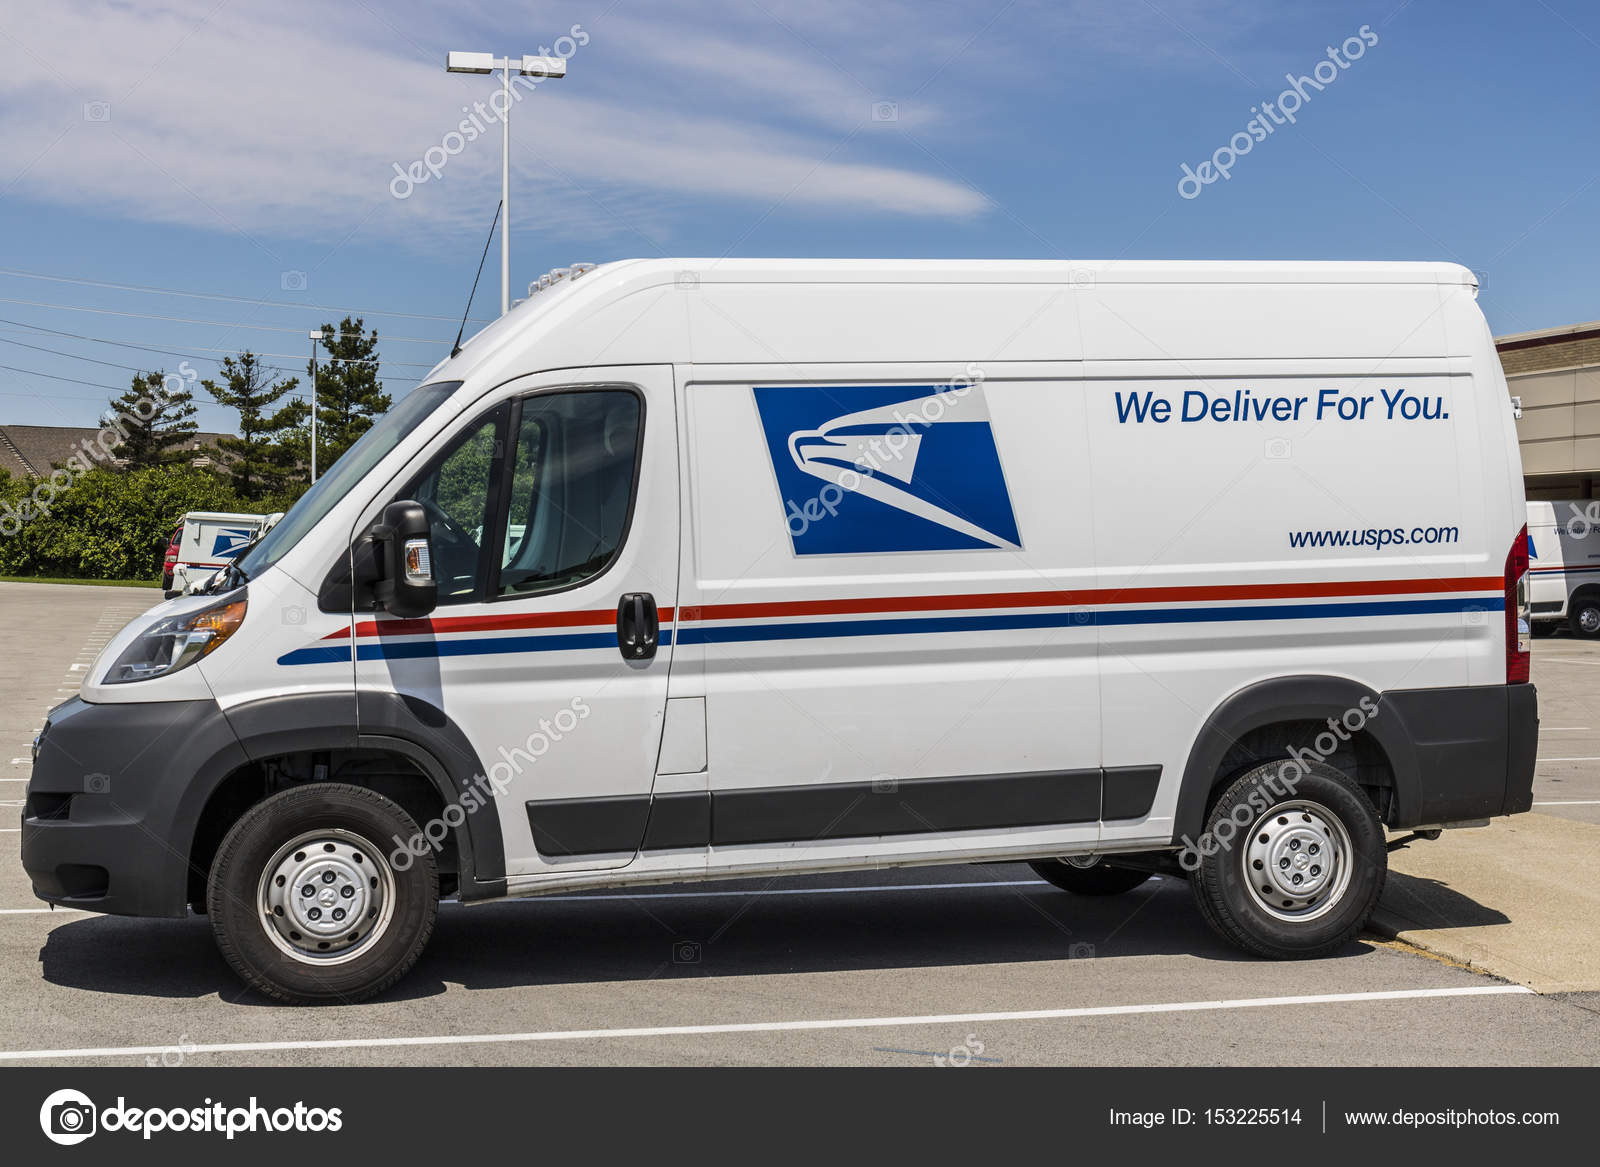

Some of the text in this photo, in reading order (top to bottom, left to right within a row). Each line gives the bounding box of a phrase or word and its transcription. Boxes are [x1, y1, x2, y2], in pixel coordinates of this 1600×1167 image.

[1114, 388, 1449, 423] We Deliver For You.
[1289, 526, 1459, 550] www.usps.com
